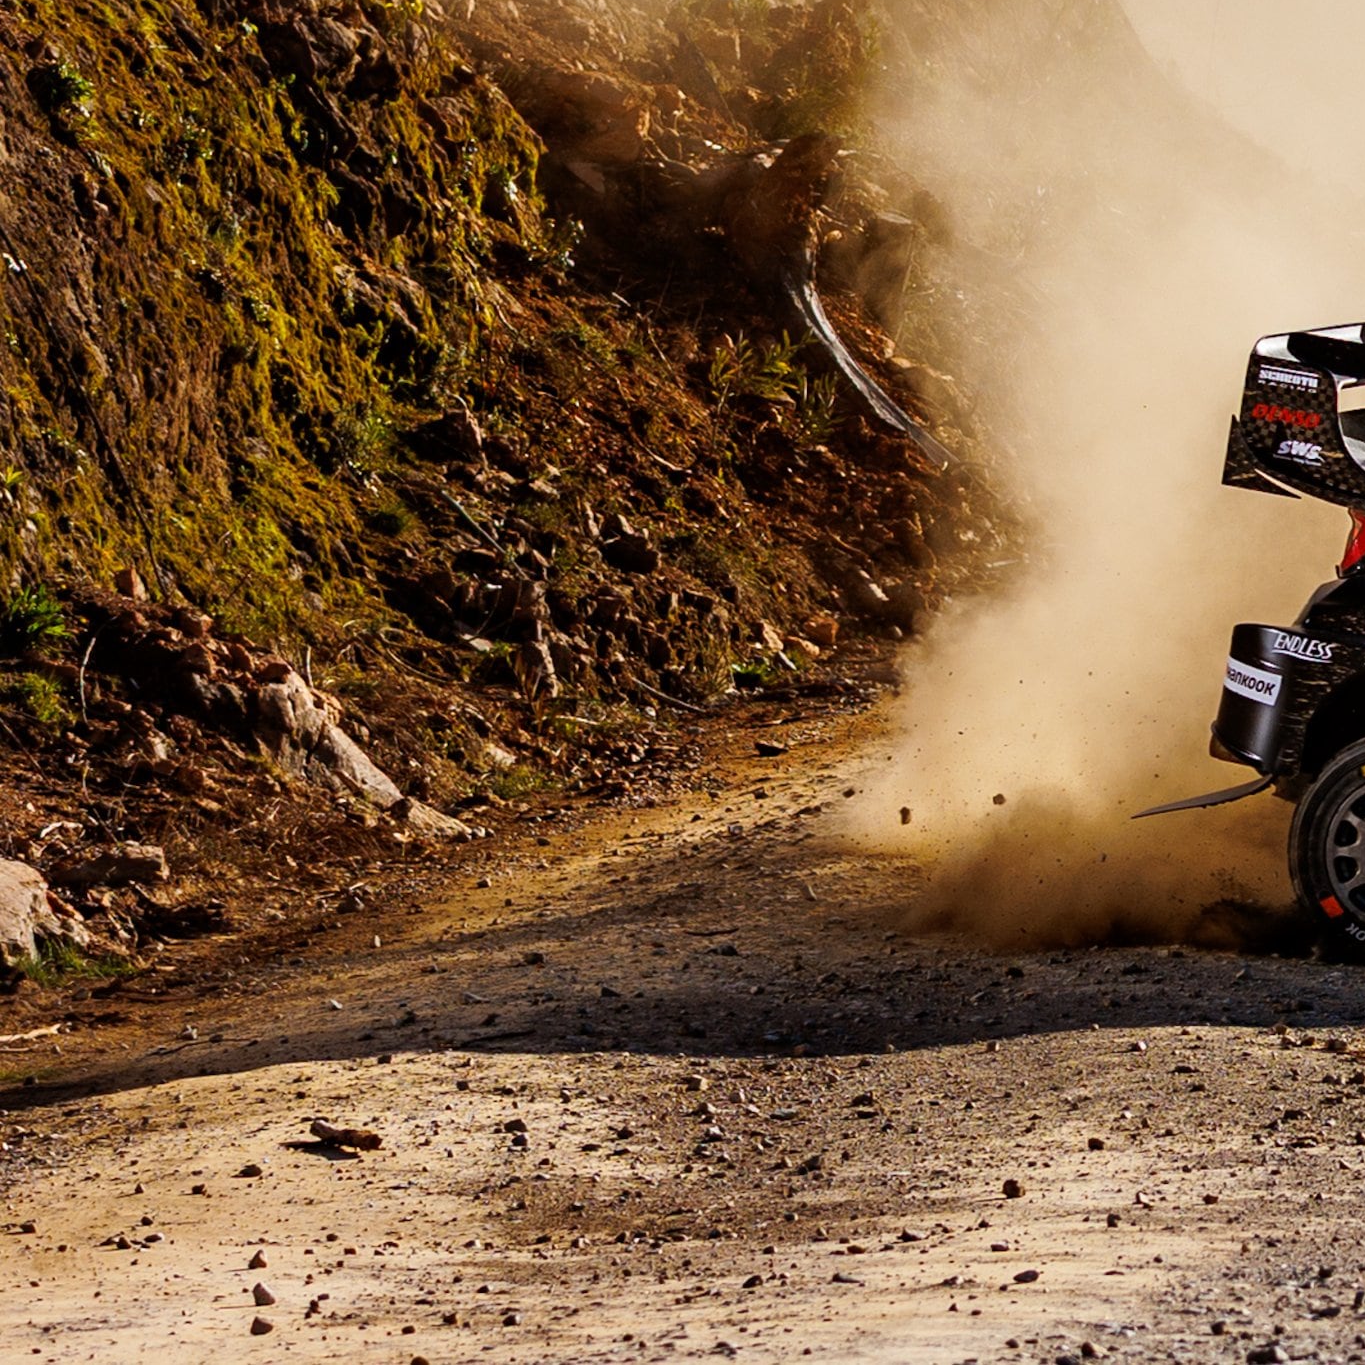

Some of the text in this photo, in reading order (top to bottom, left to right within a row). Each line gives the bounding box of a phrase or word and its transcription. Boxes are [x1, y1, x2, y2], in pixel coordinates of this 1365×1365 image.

[1252, 402, 1321, 429] DENSO
[1277, 439, 1323, 461] SWS
[1273, 633, 1335, 661] ENDLESS
